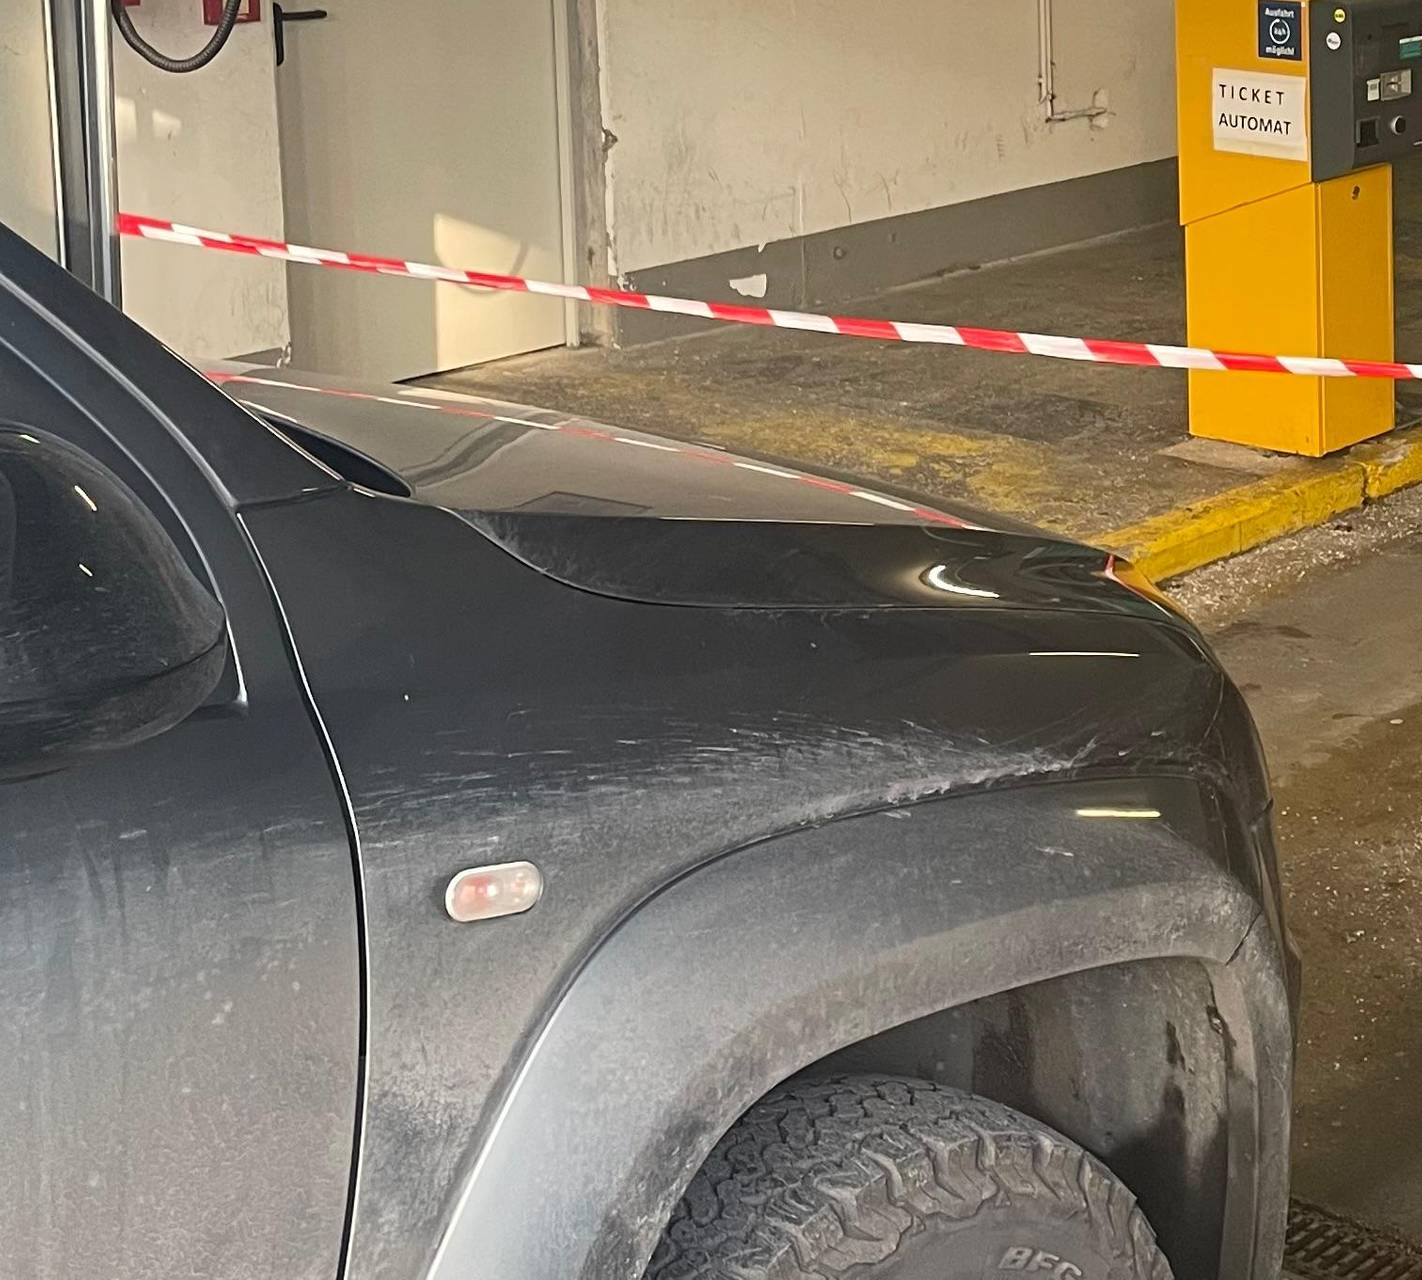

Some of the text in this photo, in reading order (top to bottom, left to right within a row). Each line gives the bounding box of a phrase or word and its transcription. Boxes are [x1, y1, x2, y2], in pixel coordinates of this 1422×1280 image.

[1265, 7, 1294, 18] Ausfahrt
[1219, 84, 1285, 105] TICKET
[1219, 112, 1291, 135] AUTOMAT
